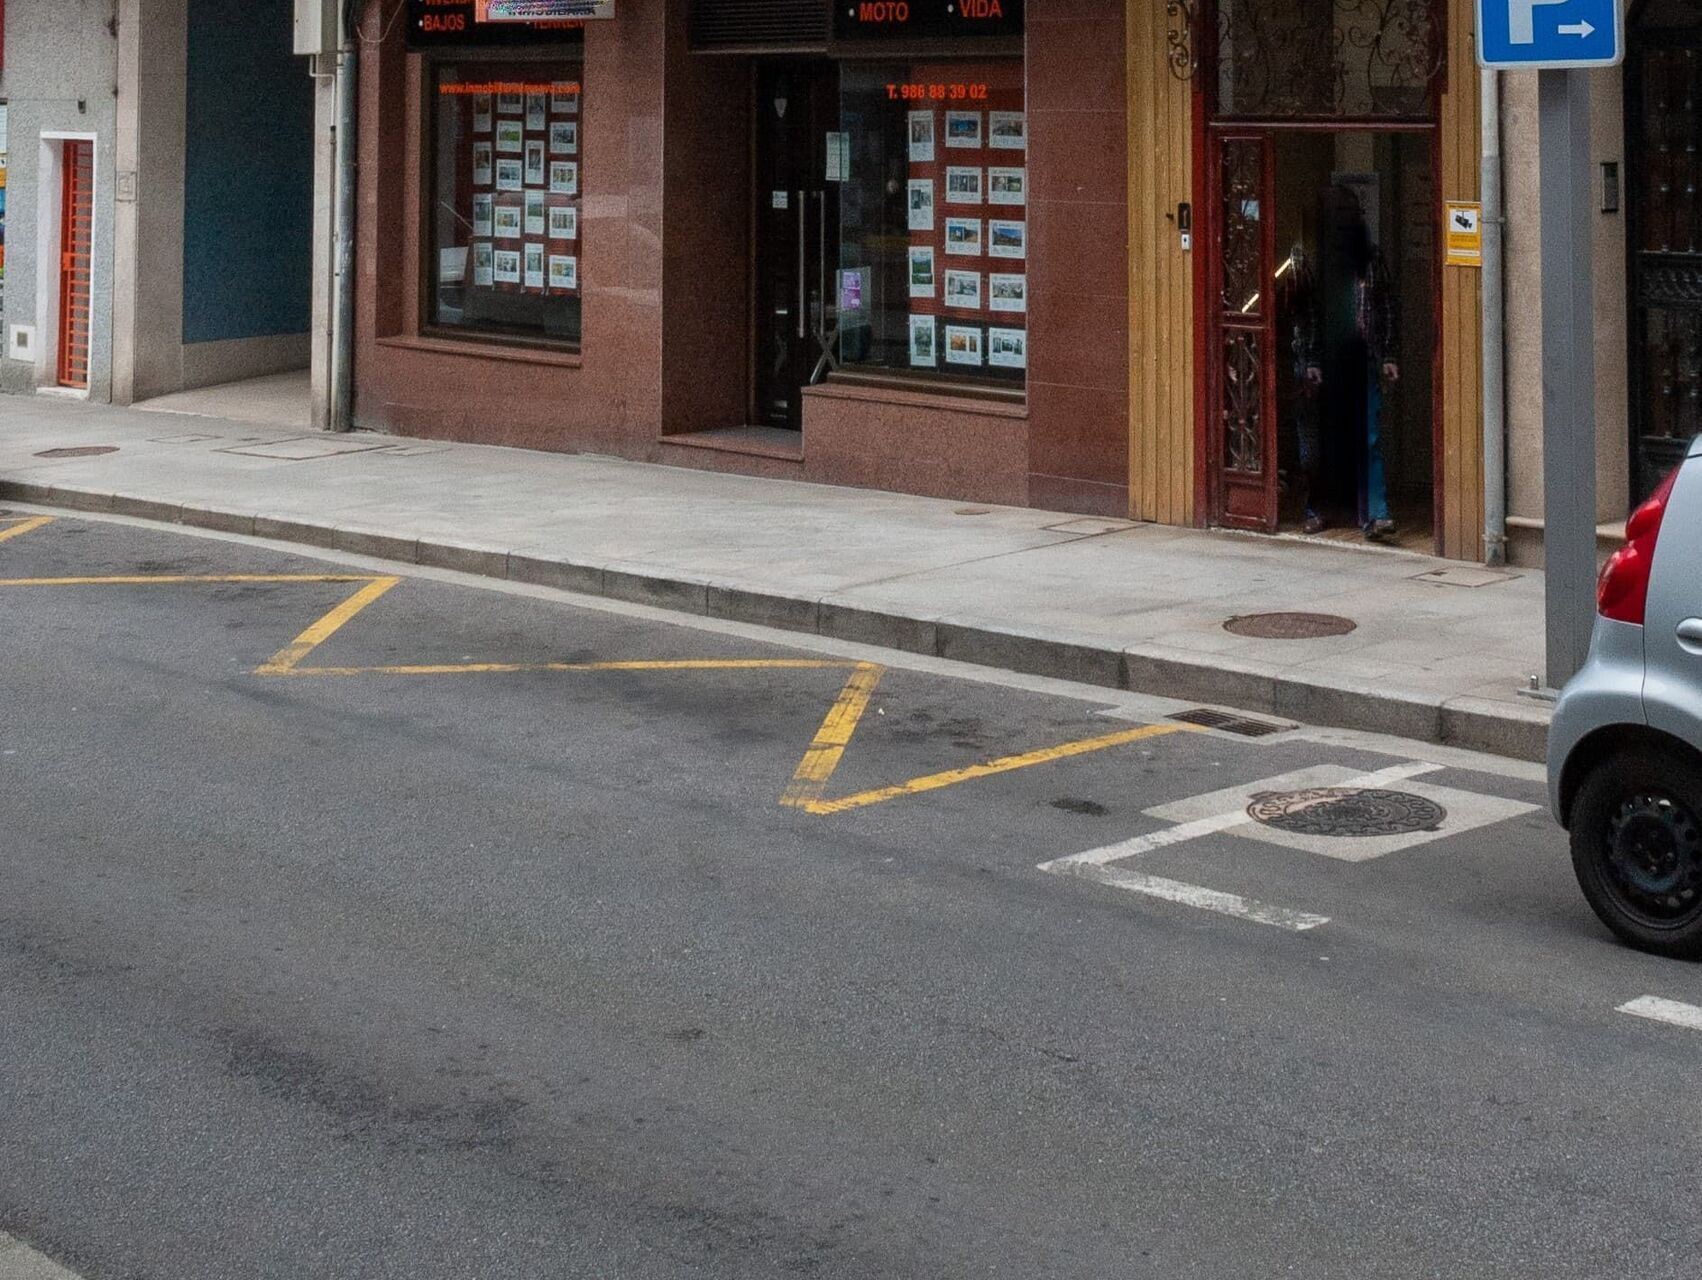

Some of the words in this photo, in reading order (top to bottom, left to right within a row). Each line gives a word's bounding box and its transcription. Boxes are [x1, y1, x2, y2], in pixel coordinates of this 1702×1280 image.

[860, 1, 909, 22] MOTO
[424, 14, 465, 31] BAJOS
[886, 84, 898, 99] T.
[901, 84, 925, 99] 986
[969, 84, 987, 99] 02
